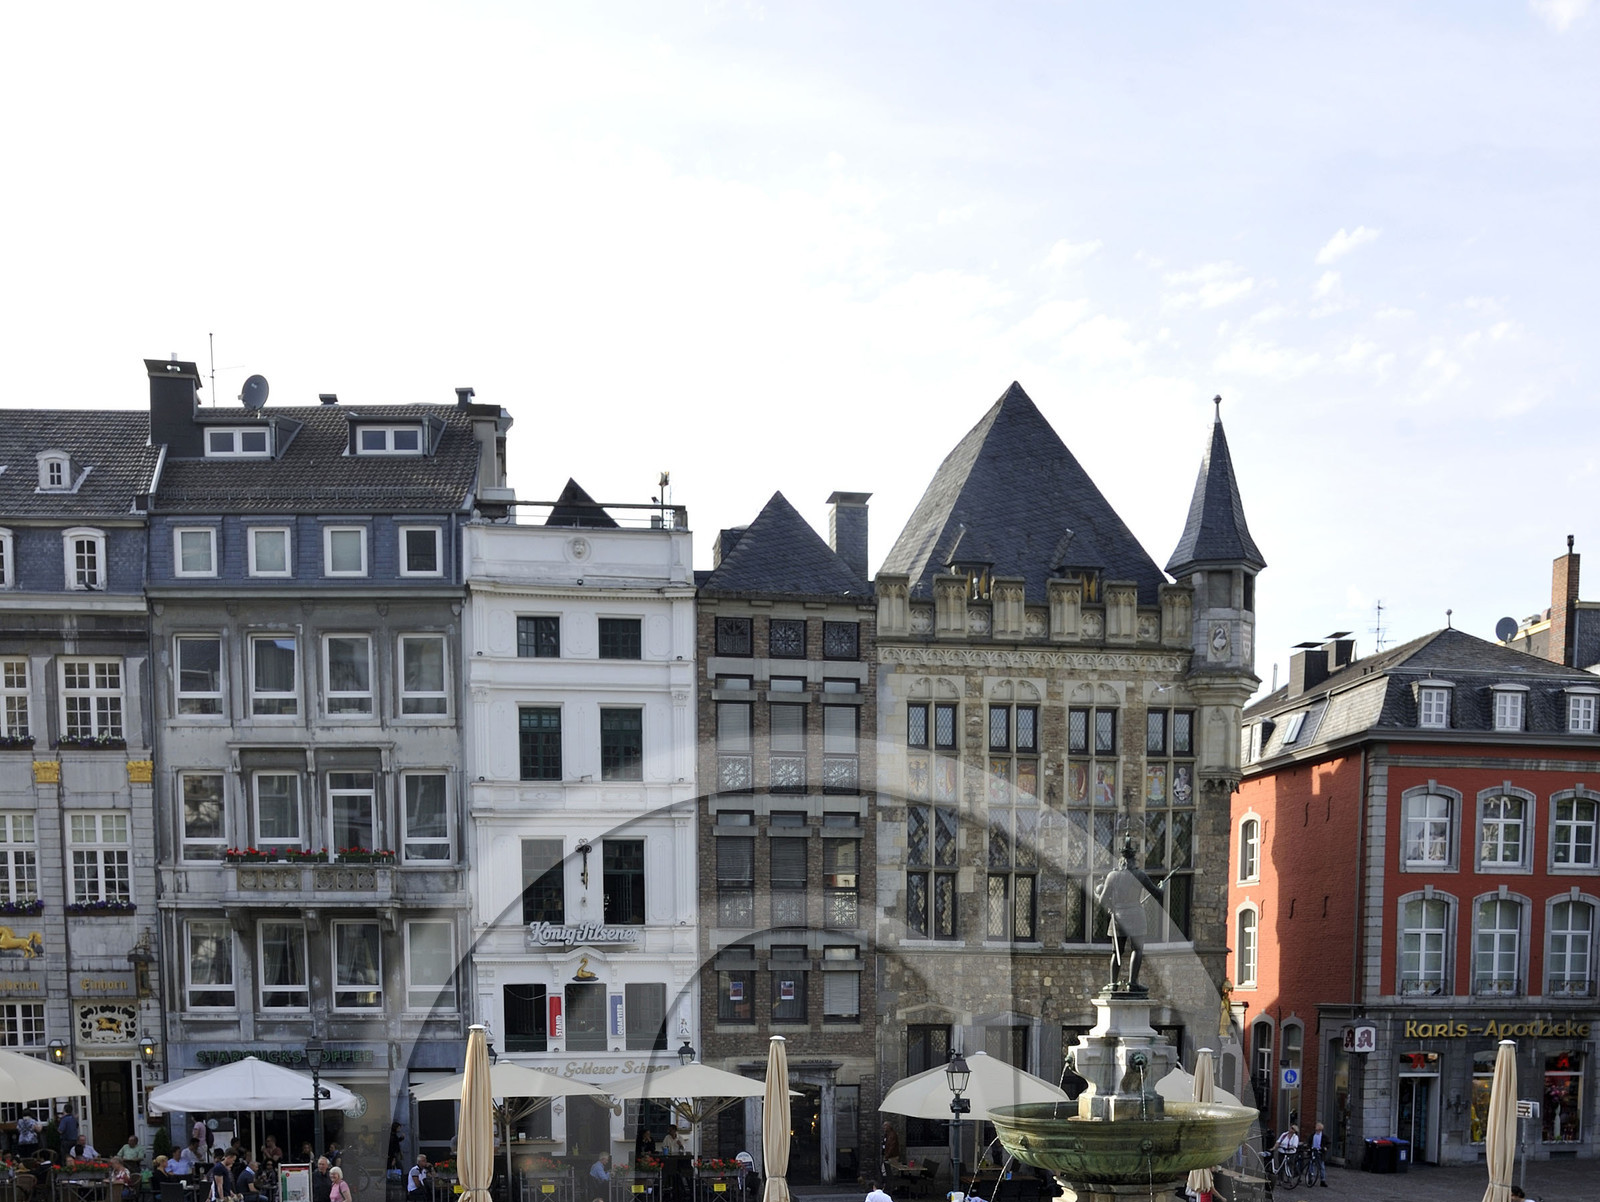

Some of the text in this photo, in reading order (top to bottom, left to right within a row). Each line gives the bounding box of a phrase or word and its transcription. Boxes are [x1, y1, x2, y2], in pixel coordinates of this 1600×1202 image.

[80, 976, 128, 992] Einhorn
[555, 1014, 563, 1037] STAND
[616, 1003, 624, 1035] QUARTIER
[148, 1072, 159, 1081] 33
[563, 1061, 619, 1078] Goldener
